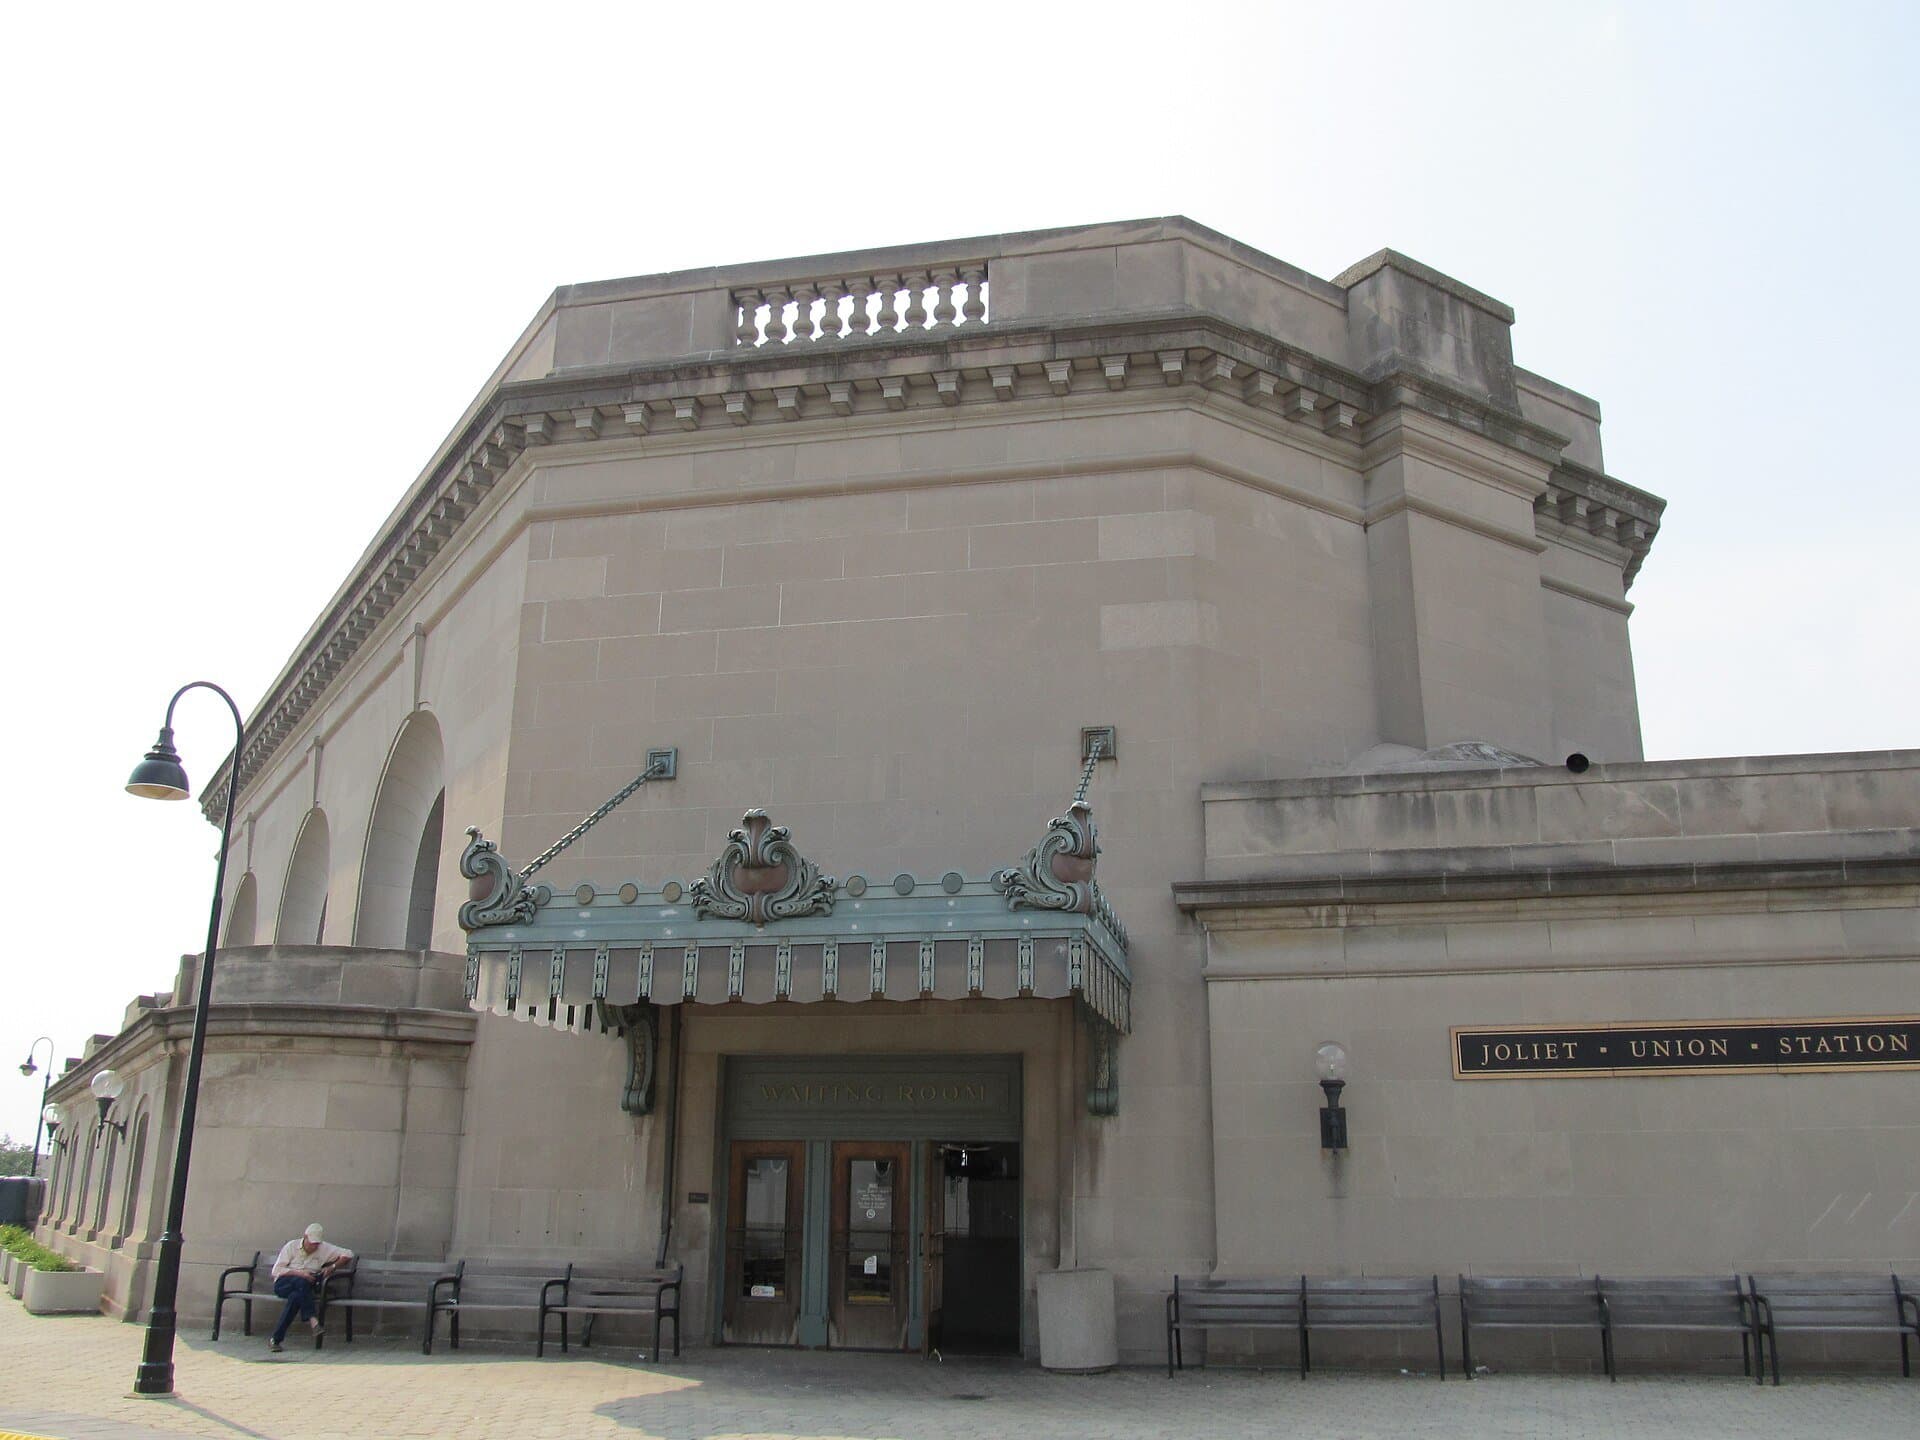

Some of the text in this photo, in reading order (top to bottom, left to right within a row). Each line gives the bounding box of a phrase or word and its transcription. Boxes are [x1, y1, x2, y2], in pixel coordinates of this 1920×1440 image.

[1481, 1034, 1909, 1066] JOLIET UNION STATION
[760, 1084, 986, 1101] WAITING ROOM
